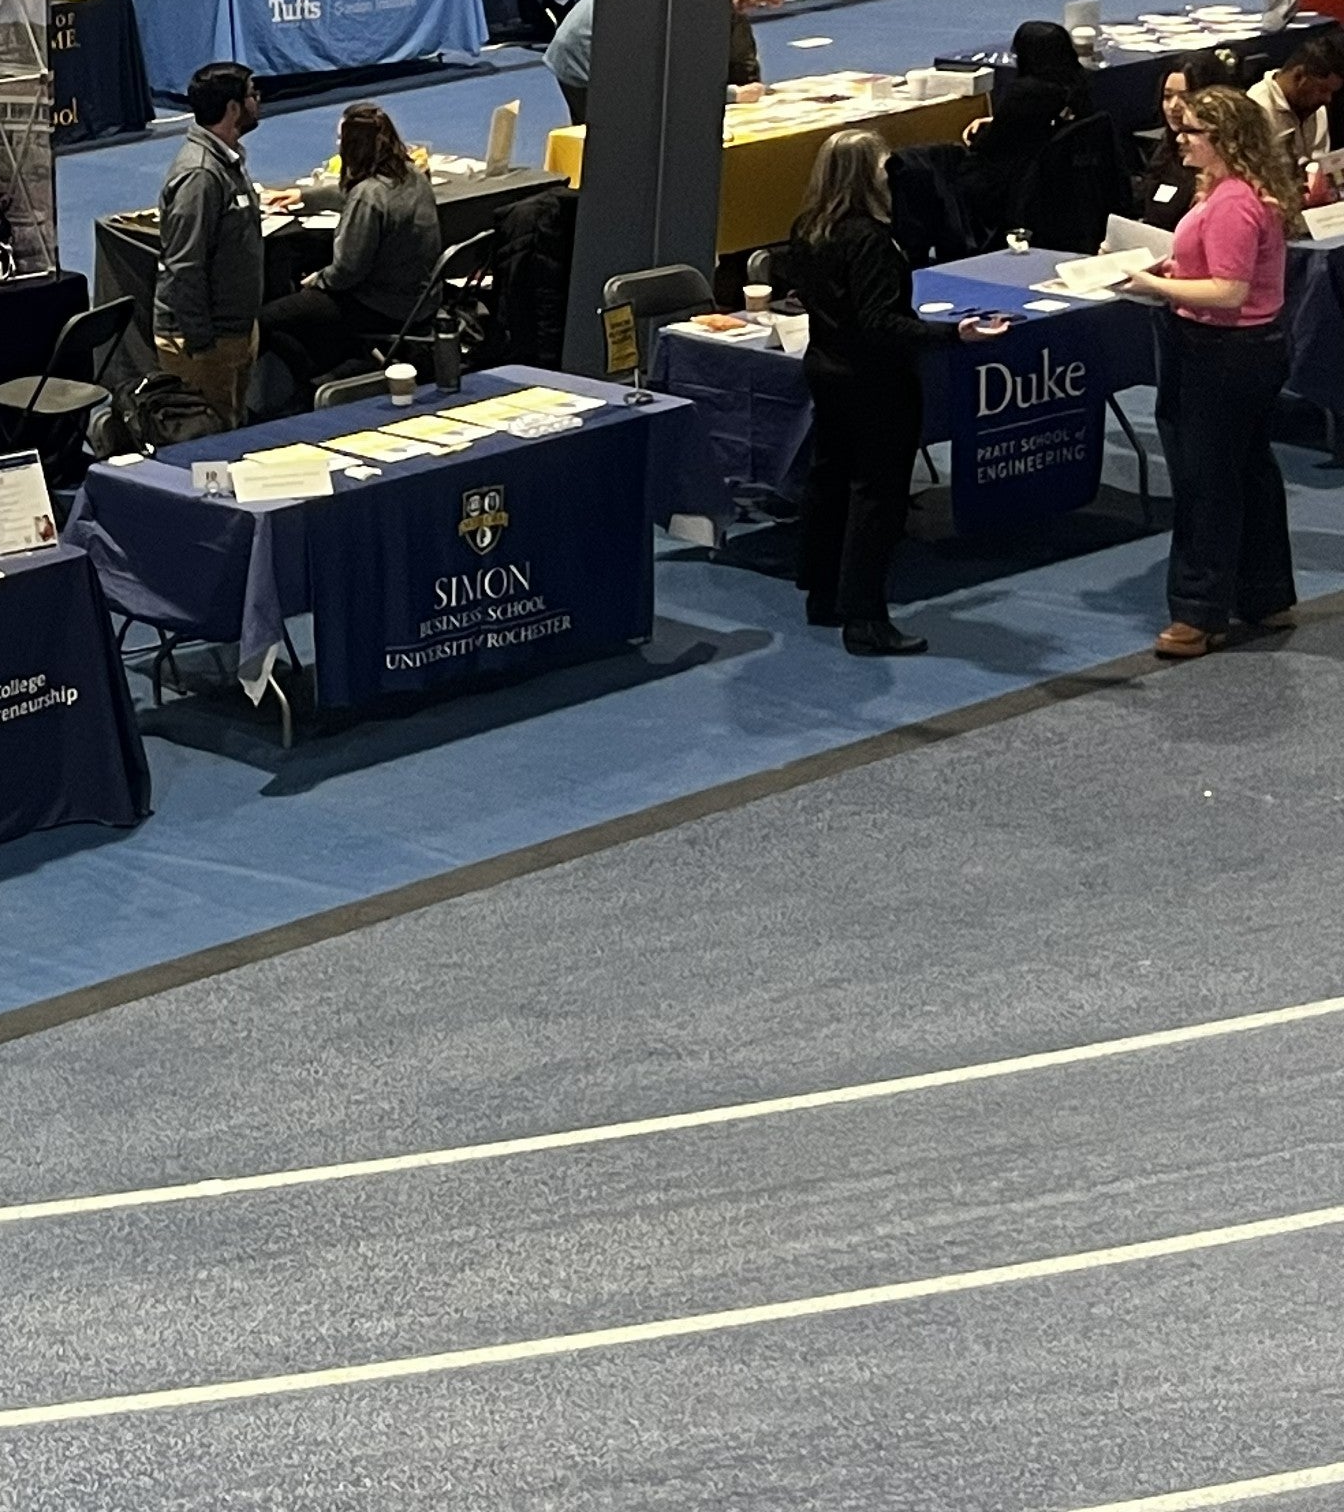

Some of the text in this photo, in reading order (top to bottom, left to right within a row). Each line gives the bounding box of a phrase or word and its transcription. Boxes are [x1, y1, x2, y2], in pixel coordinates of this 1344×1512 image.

[976, 347, 1087, 418] Duke
[977, 440, 1015, 463] PRATT
[1021, 429, 1070, 452] SCHOOL
[977, 444, 1086, 484] ENGINEERING
[433, 561, 531, 610] SIMON
[419, 595, 547, 638] BUSINESS SCHOOL
[487, 615, 572, 649] ROCHESTER
